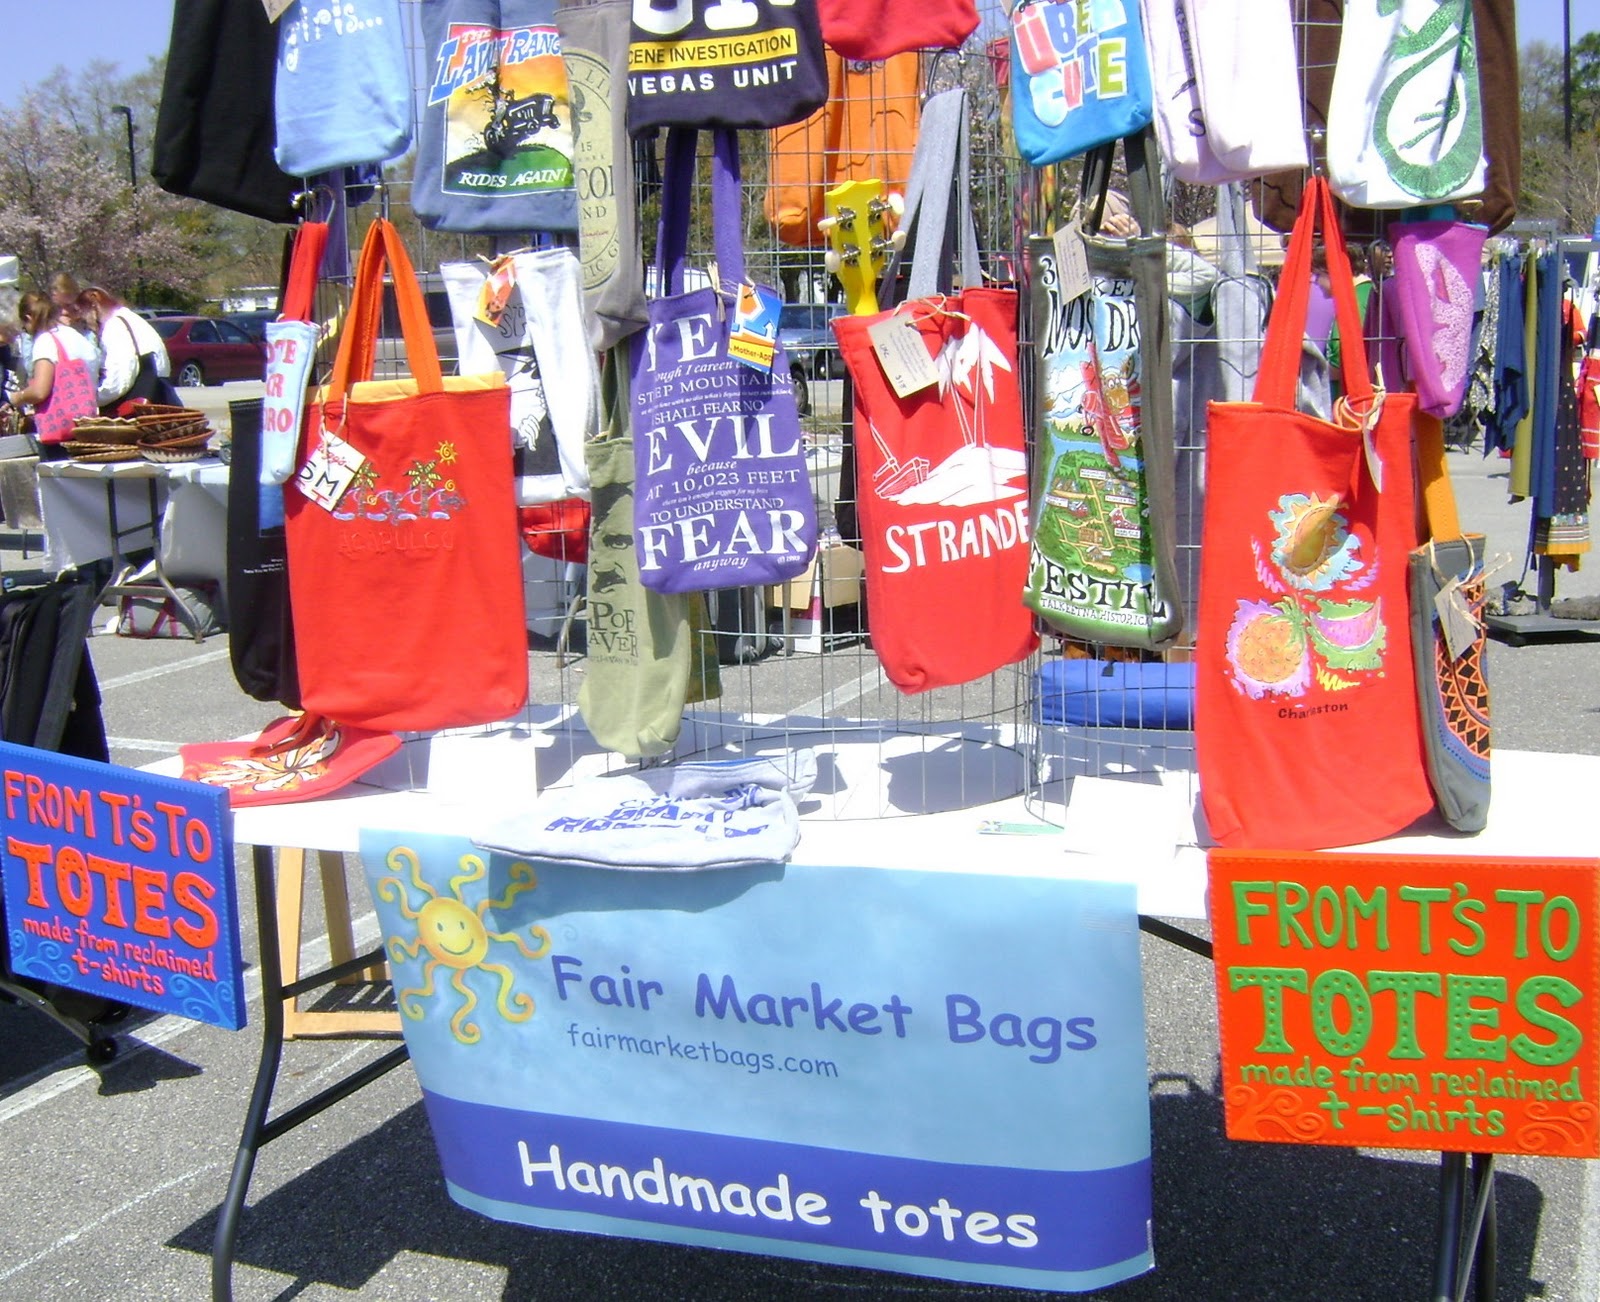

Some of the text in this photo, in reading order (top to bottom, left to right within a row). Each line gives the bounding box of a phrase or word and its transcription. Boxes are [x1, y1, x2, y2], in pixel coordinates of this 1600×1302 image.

[669, 34, 792, 63] INVESTIGATION
[733, 61, 798, 88] UNIT
[1029, 33, 1128, 128] CUTE
[458, 168, 568, 188] RIDES AGAIN!
[654, 406, 701, 425] SHALL
[703, 401, 742, 416] FEAR
[742, 399, 765, 413] NO
[644, 413, 800, 476] EVIL
[686, 460, 737, 476] because
[645, 469, 800, 501] AT 10,023 FEET
[650, 497, 784, 524] TO UNDERSTAND
[638, 509, 809, 571] FEAR
[693, 555, 749, 572] anyway
[4, 769, 96, 838] FROM
[156, 801, 213, 863] TO
[7, 836, 219, 948] TOTES
[23, 916, 217, 982] made from reclaimed
[1231, 881, 1390, 950] FROM
[1495, 889, 1581, 962] TO
[71, 949, 165, 995] t-shirts
[551, 954, 1098, 1065] Fair Market Bags
[1228, 966, 1584, 1067] TOTES
[567, 1021, 840, 1079] fairmarketbags.com
[1240, 1056, 1584, 1102] made from reclaimed
[517, 1139, 1039, 1250] Handmade totes
